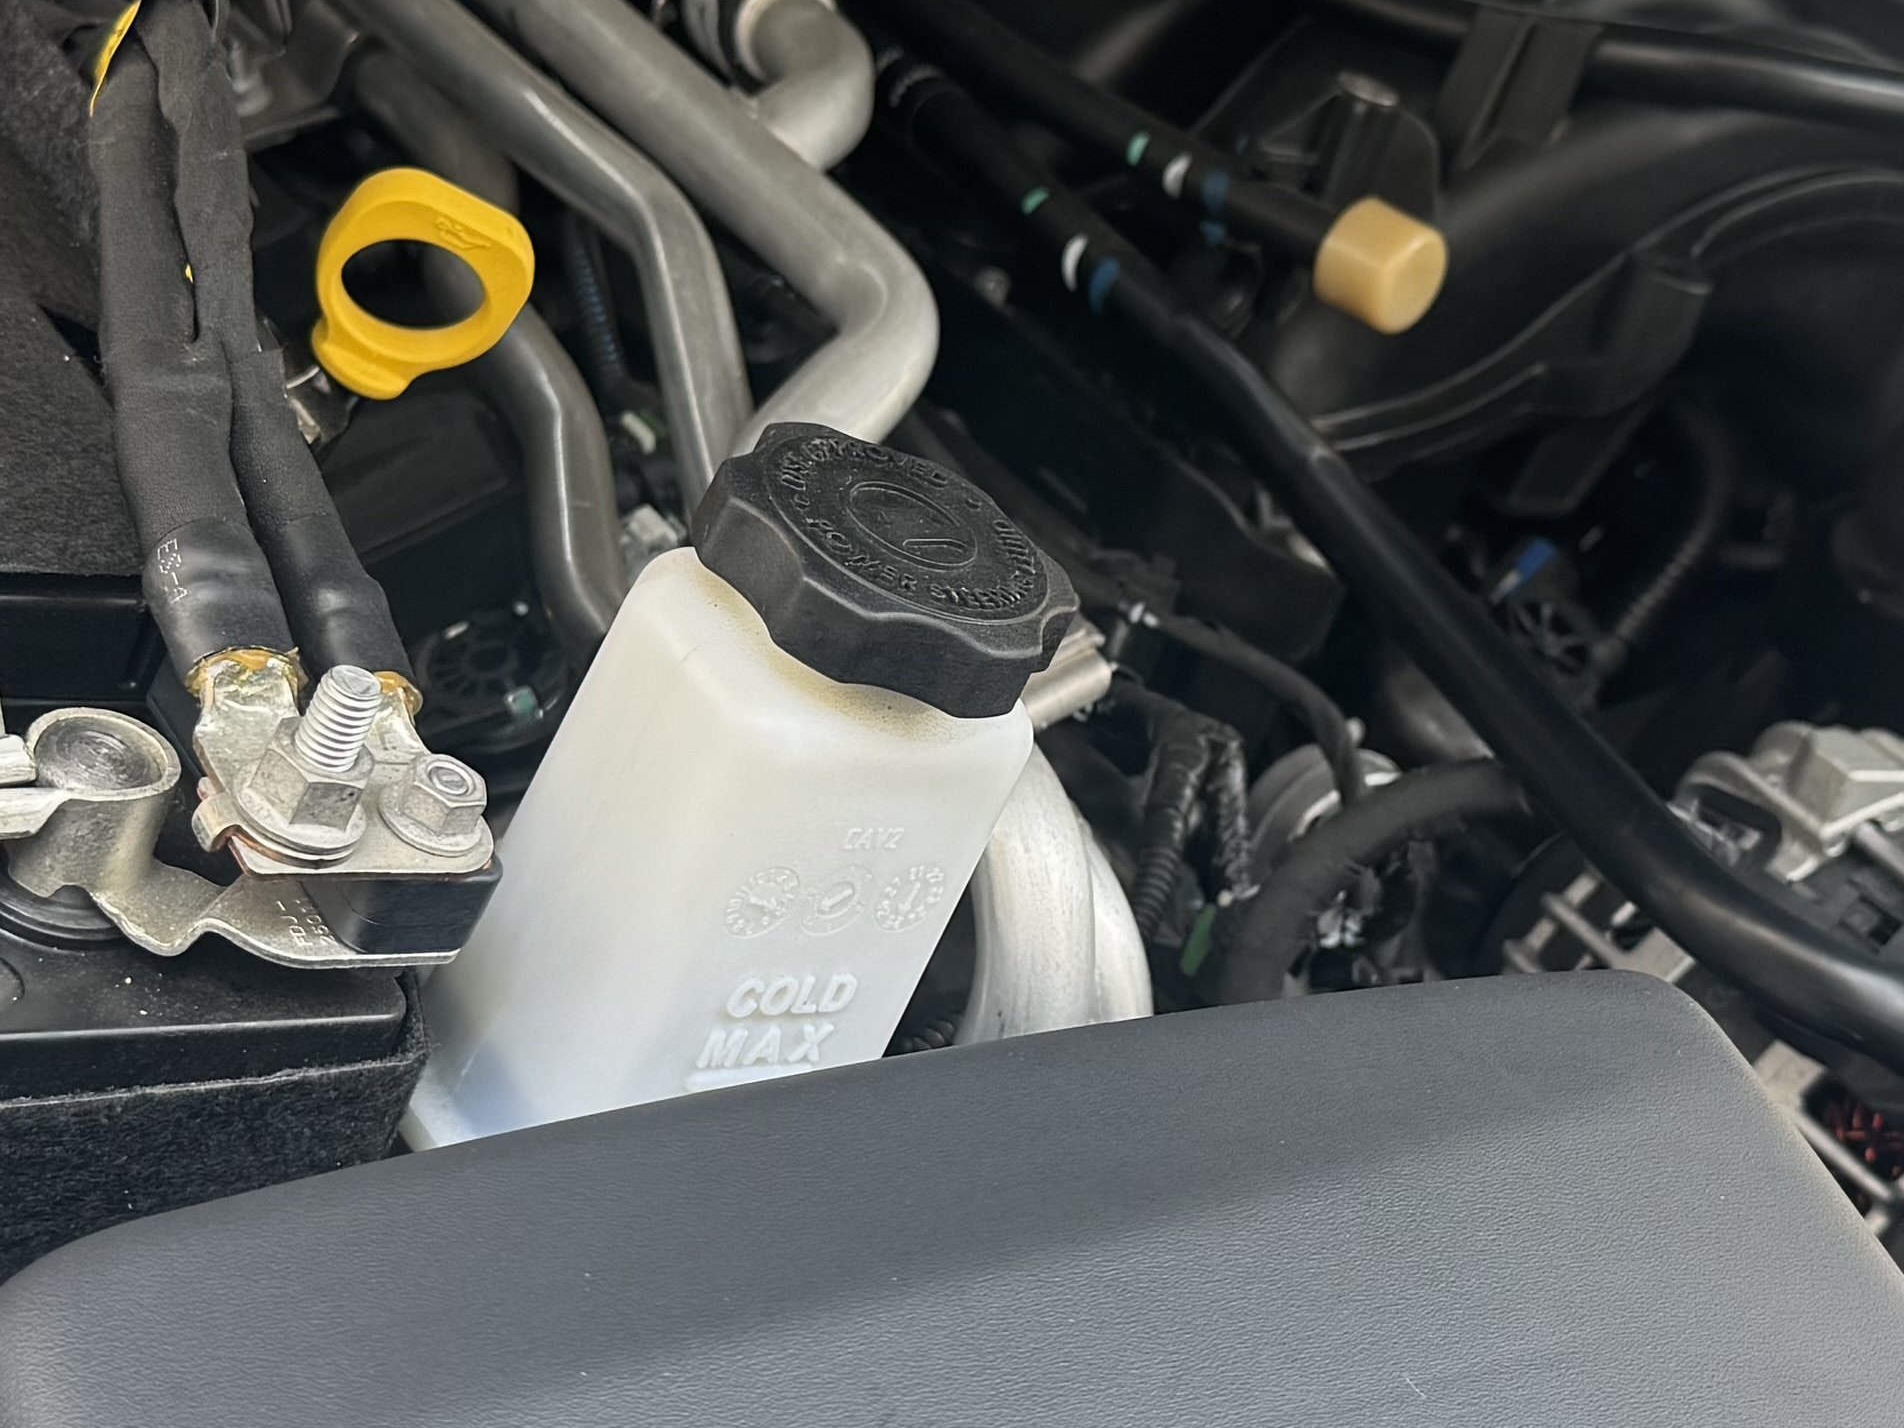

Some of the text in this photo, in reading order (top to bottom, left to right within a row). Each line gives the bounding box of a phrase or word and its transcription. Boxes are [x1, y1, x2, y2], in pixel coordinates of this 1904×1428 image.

[806, 517, 918, 594] POWER
[726, 971, 858, 1019] COLD
[697, 1020, 834, 1068] MAX
